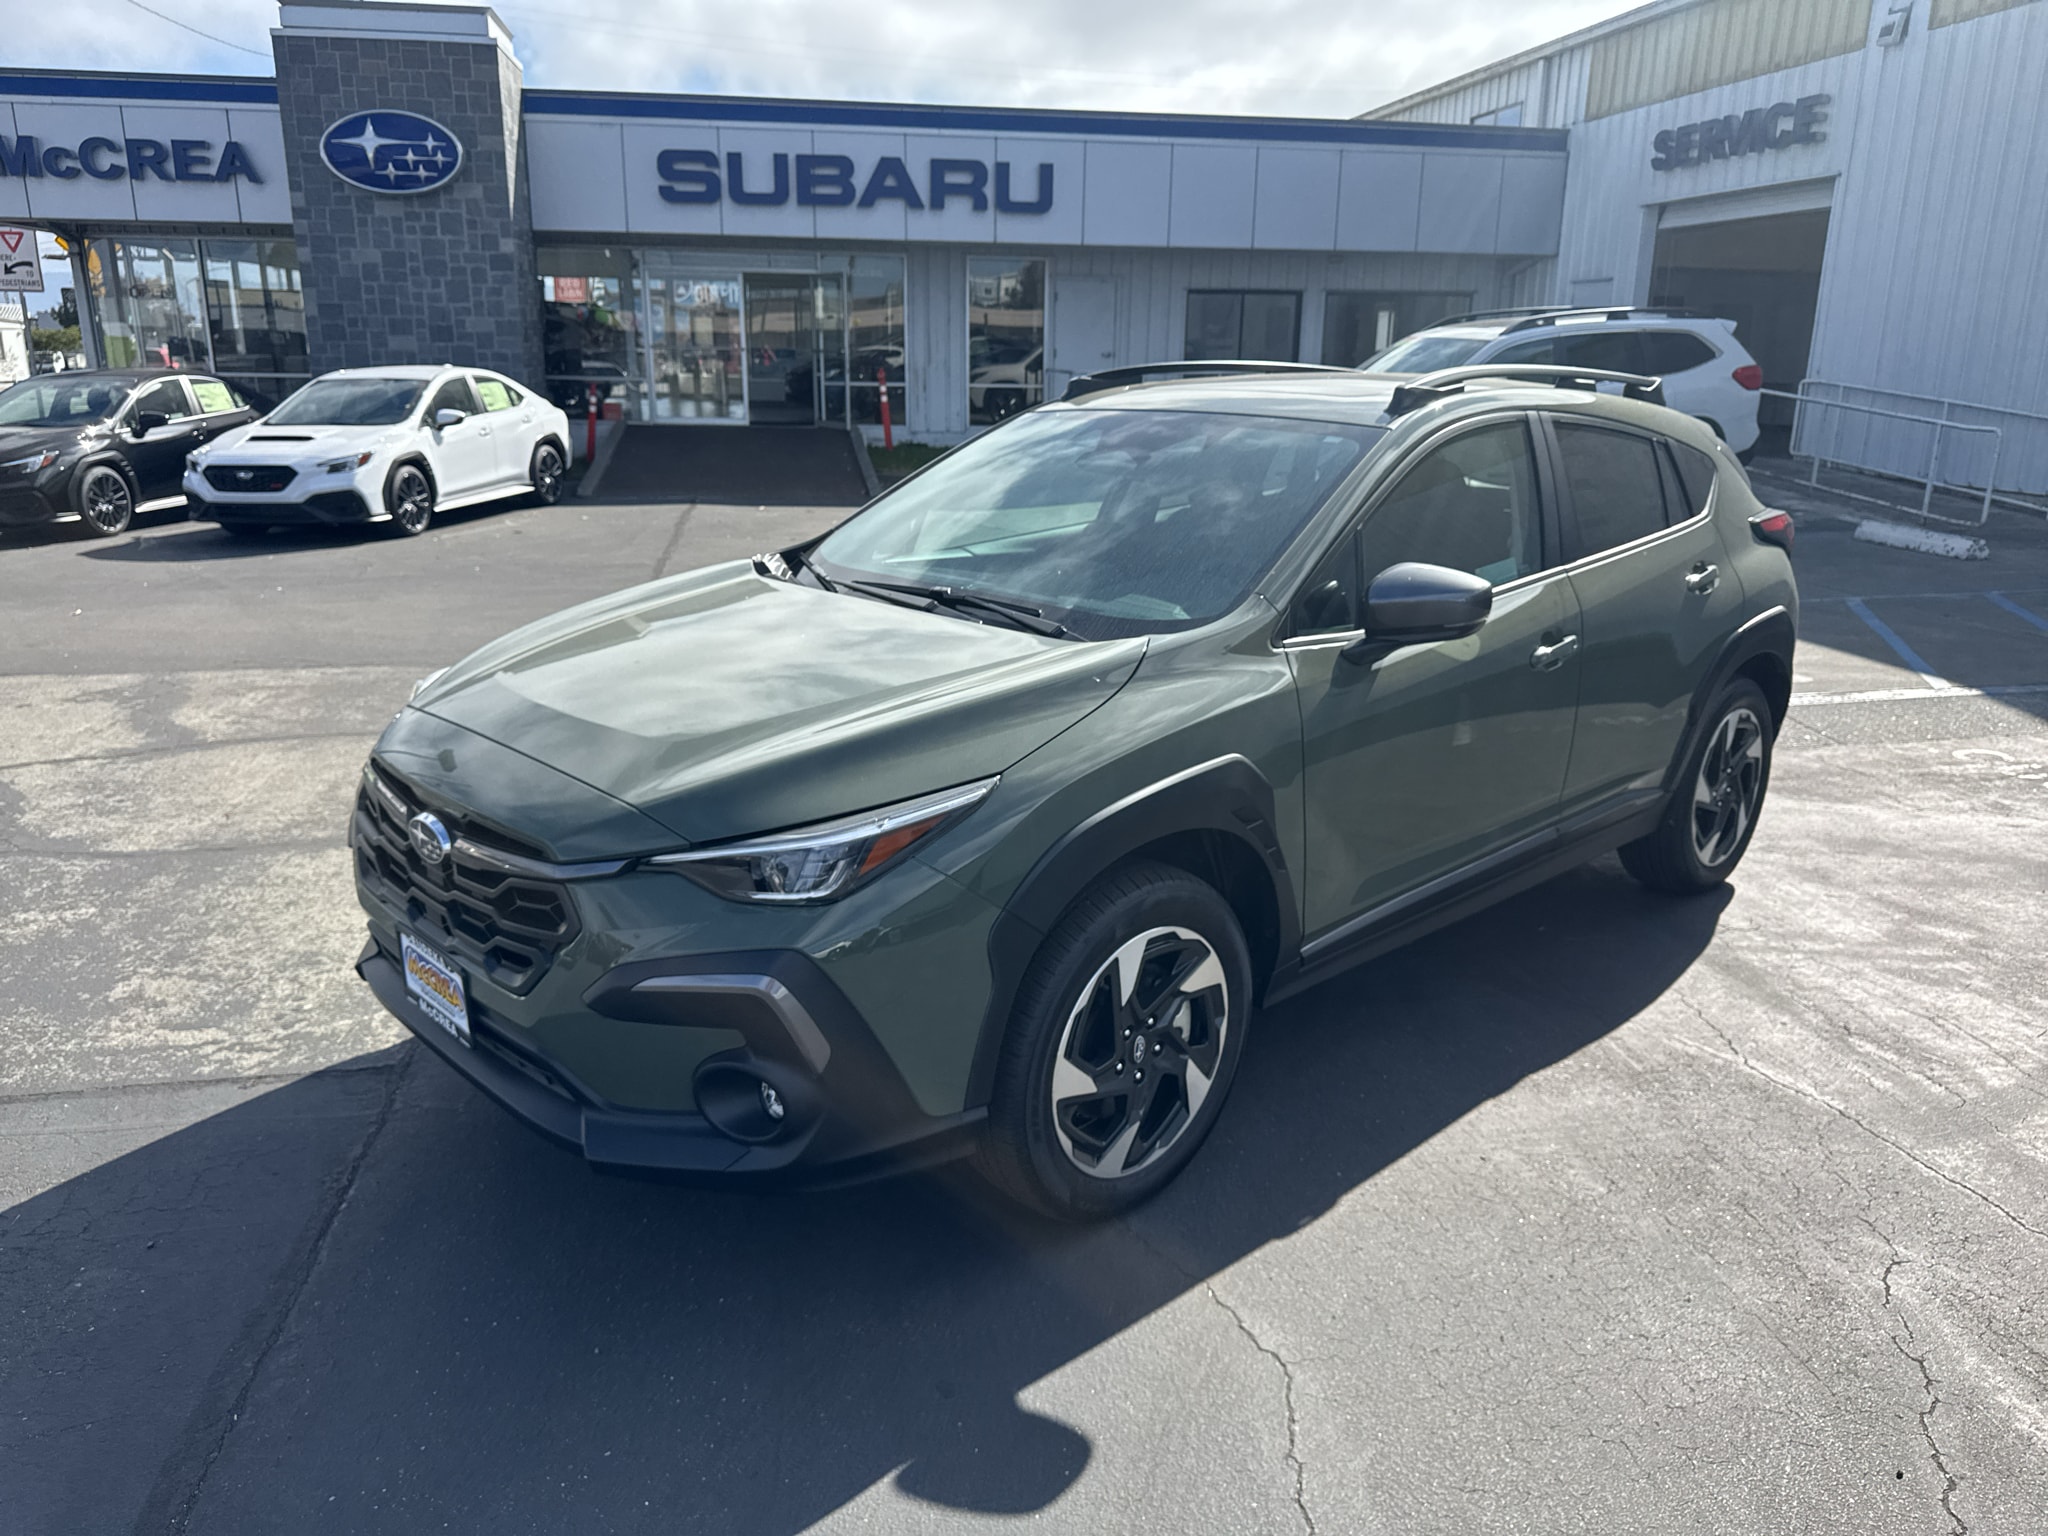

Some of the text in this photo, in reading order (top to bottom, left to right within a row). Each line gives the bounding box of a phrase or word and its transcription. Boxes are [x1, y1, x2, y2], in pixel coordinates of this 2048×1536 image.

[0, 135, 263, 184] McCREA
[1651, 93, 1832, 171] SERVICE
[656, 149, 1055, 214] SUBARU
